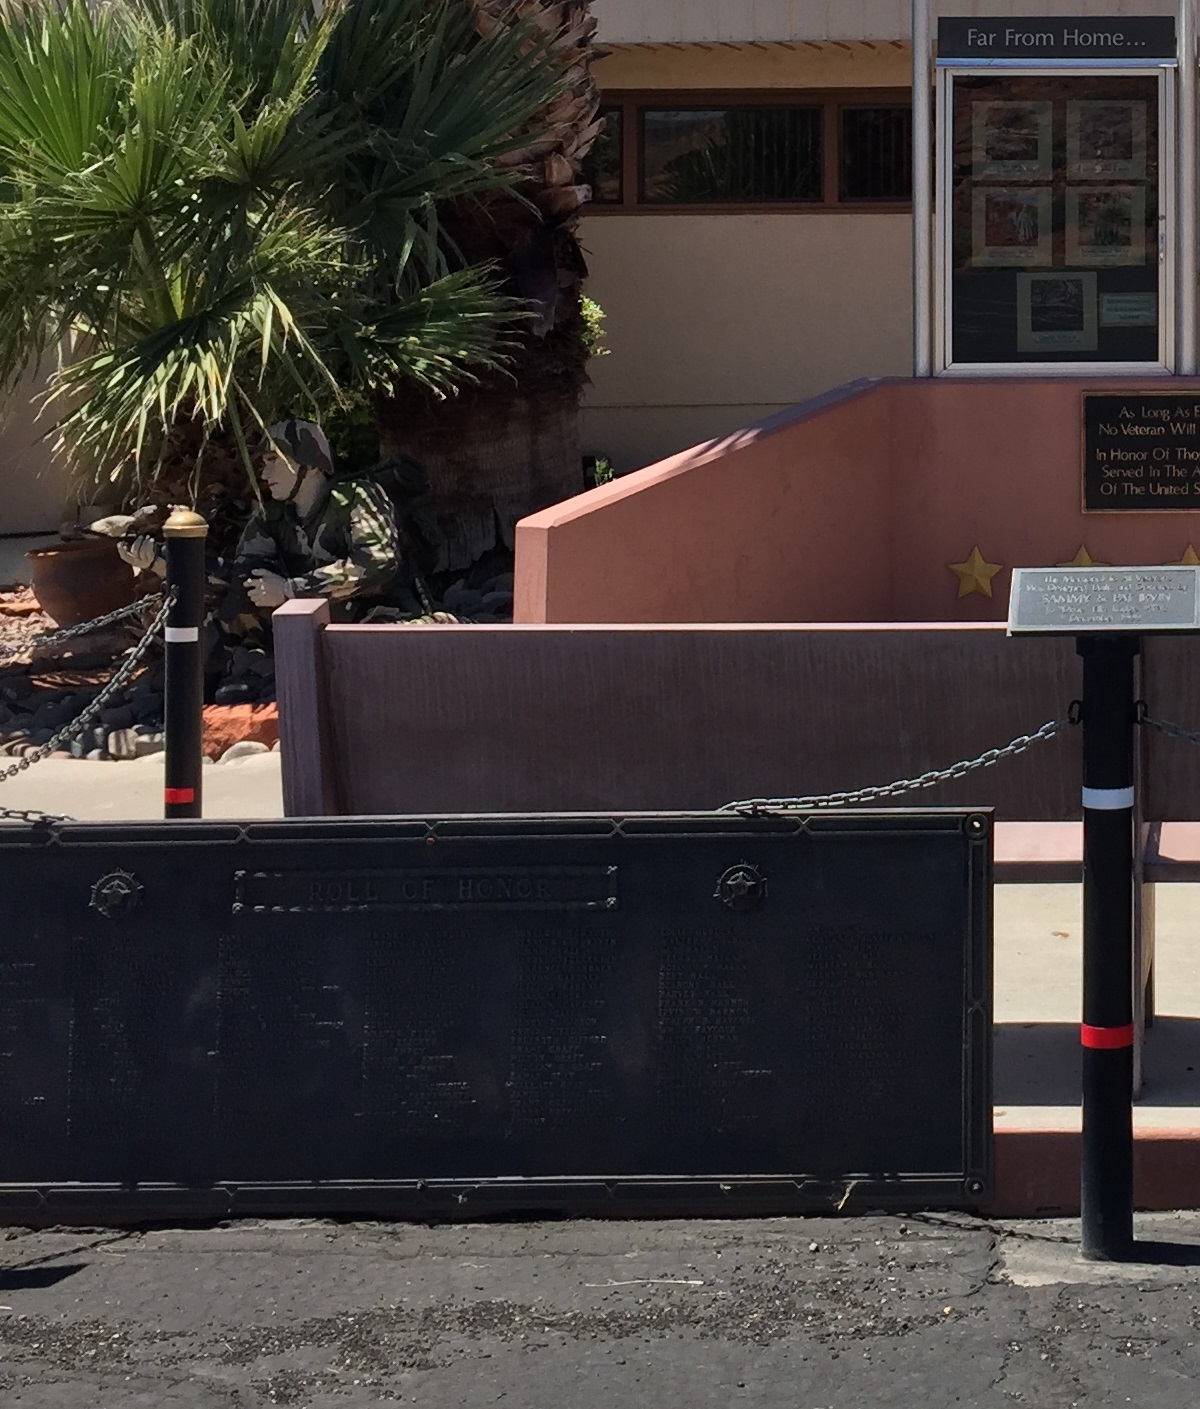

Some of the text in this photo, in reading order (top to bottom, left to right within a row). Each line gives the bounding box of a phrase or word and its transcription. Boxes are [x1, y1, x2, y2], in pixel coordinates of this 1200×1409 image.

[967, 28, 1146, 47] Far From Home...
[1119, 406, 1135, 418] As
[1141, 406, 1170, 421] Long
[1174, 406, 1190, 418] As
[1098, 423, 1117, 436] No
[1120, 423, 1165, 435] Veteran
[1170, 422, 1196, 435] Will
[1096, 448, 1106, 461] In
[1110, 448, 1148, 461] Honor
[1153, 447, 1170, 461] Of
[1101, 465, 1144, 478] Served
[1149, 465, 1161, 477] In
[1164, 464, 1187, 478] The
[1100, 483, 1118, 496] Of
[1122, 483, 1145, 495] The
[1149, 482, 1189, 495] United
[309, 878, 553, 901] ROLL OF HONOR
